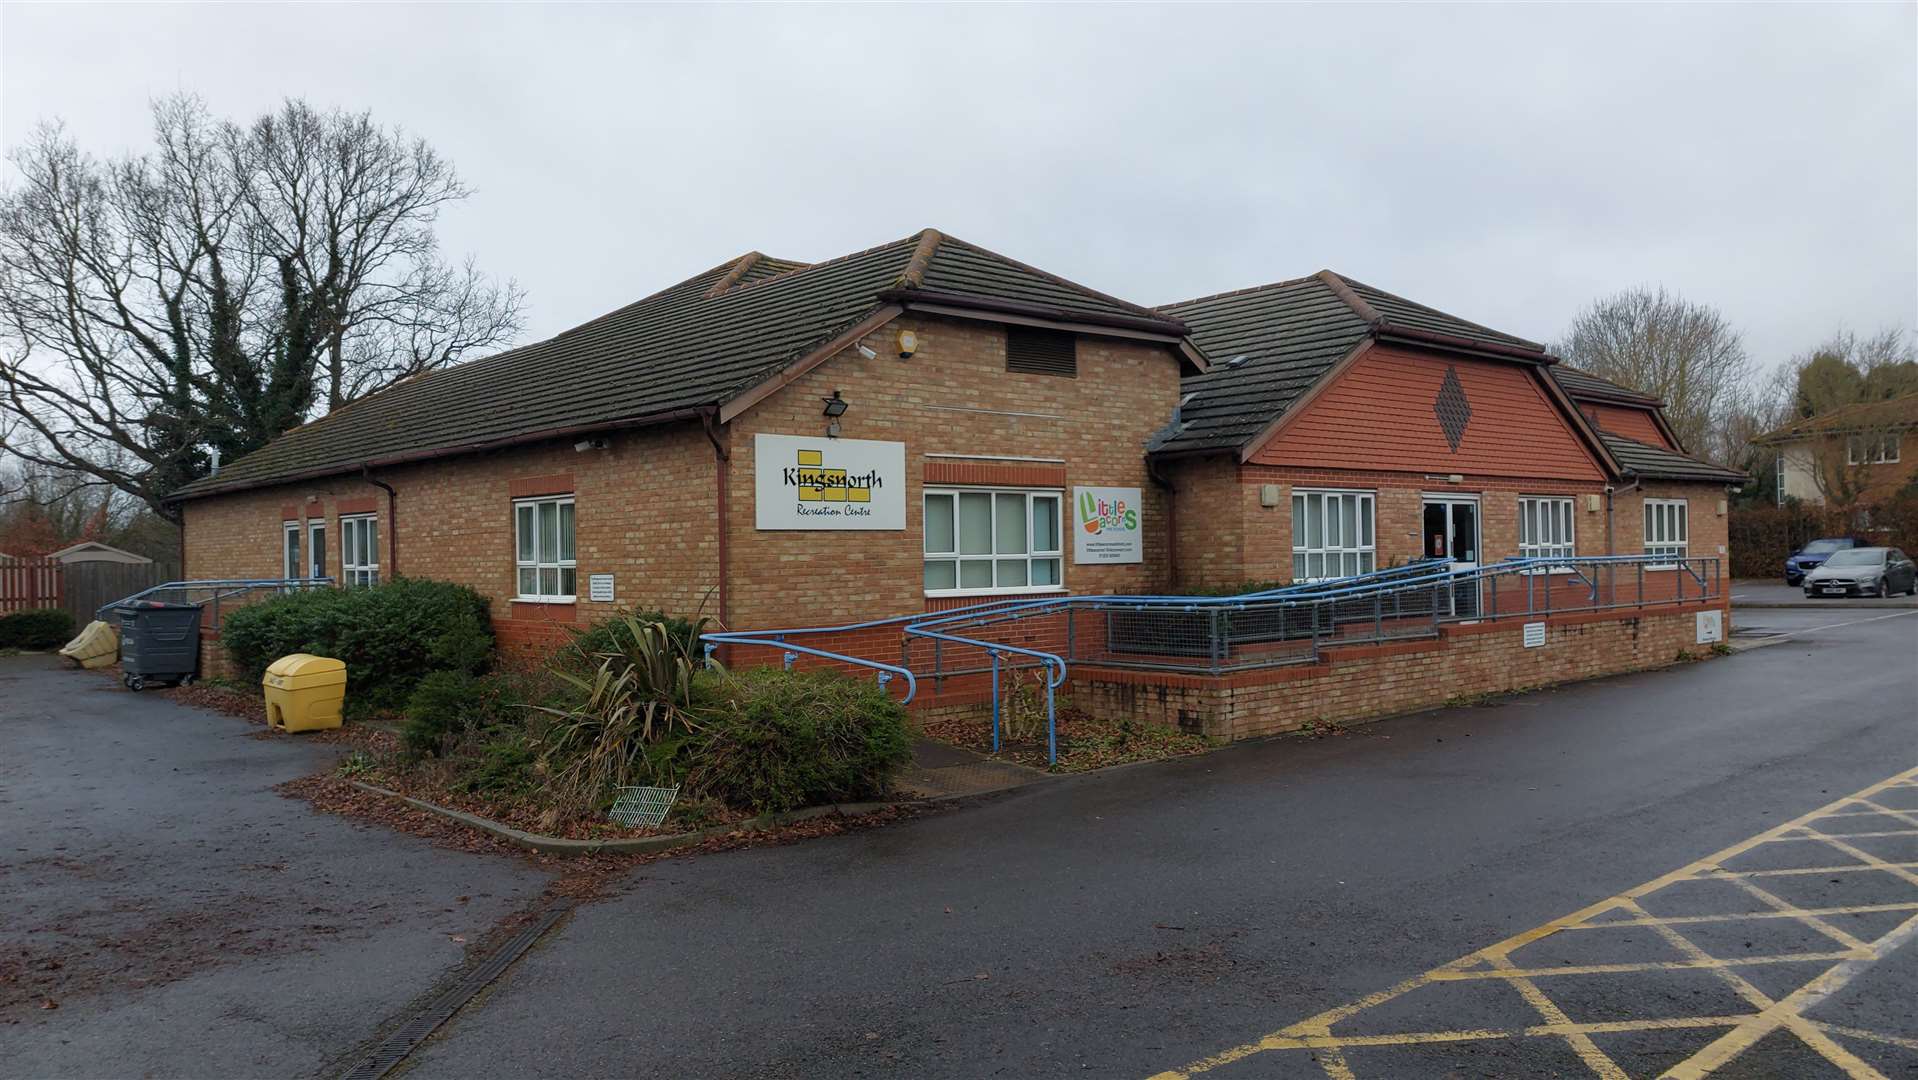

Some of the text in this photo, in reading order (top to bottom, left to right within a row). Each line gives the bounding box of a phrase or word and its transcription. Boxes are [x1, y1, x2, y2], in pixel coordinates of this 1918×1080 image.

[783, 467, 883, 492] Kingsnorth
[796, 503, 871, 516] Recreation Centre
